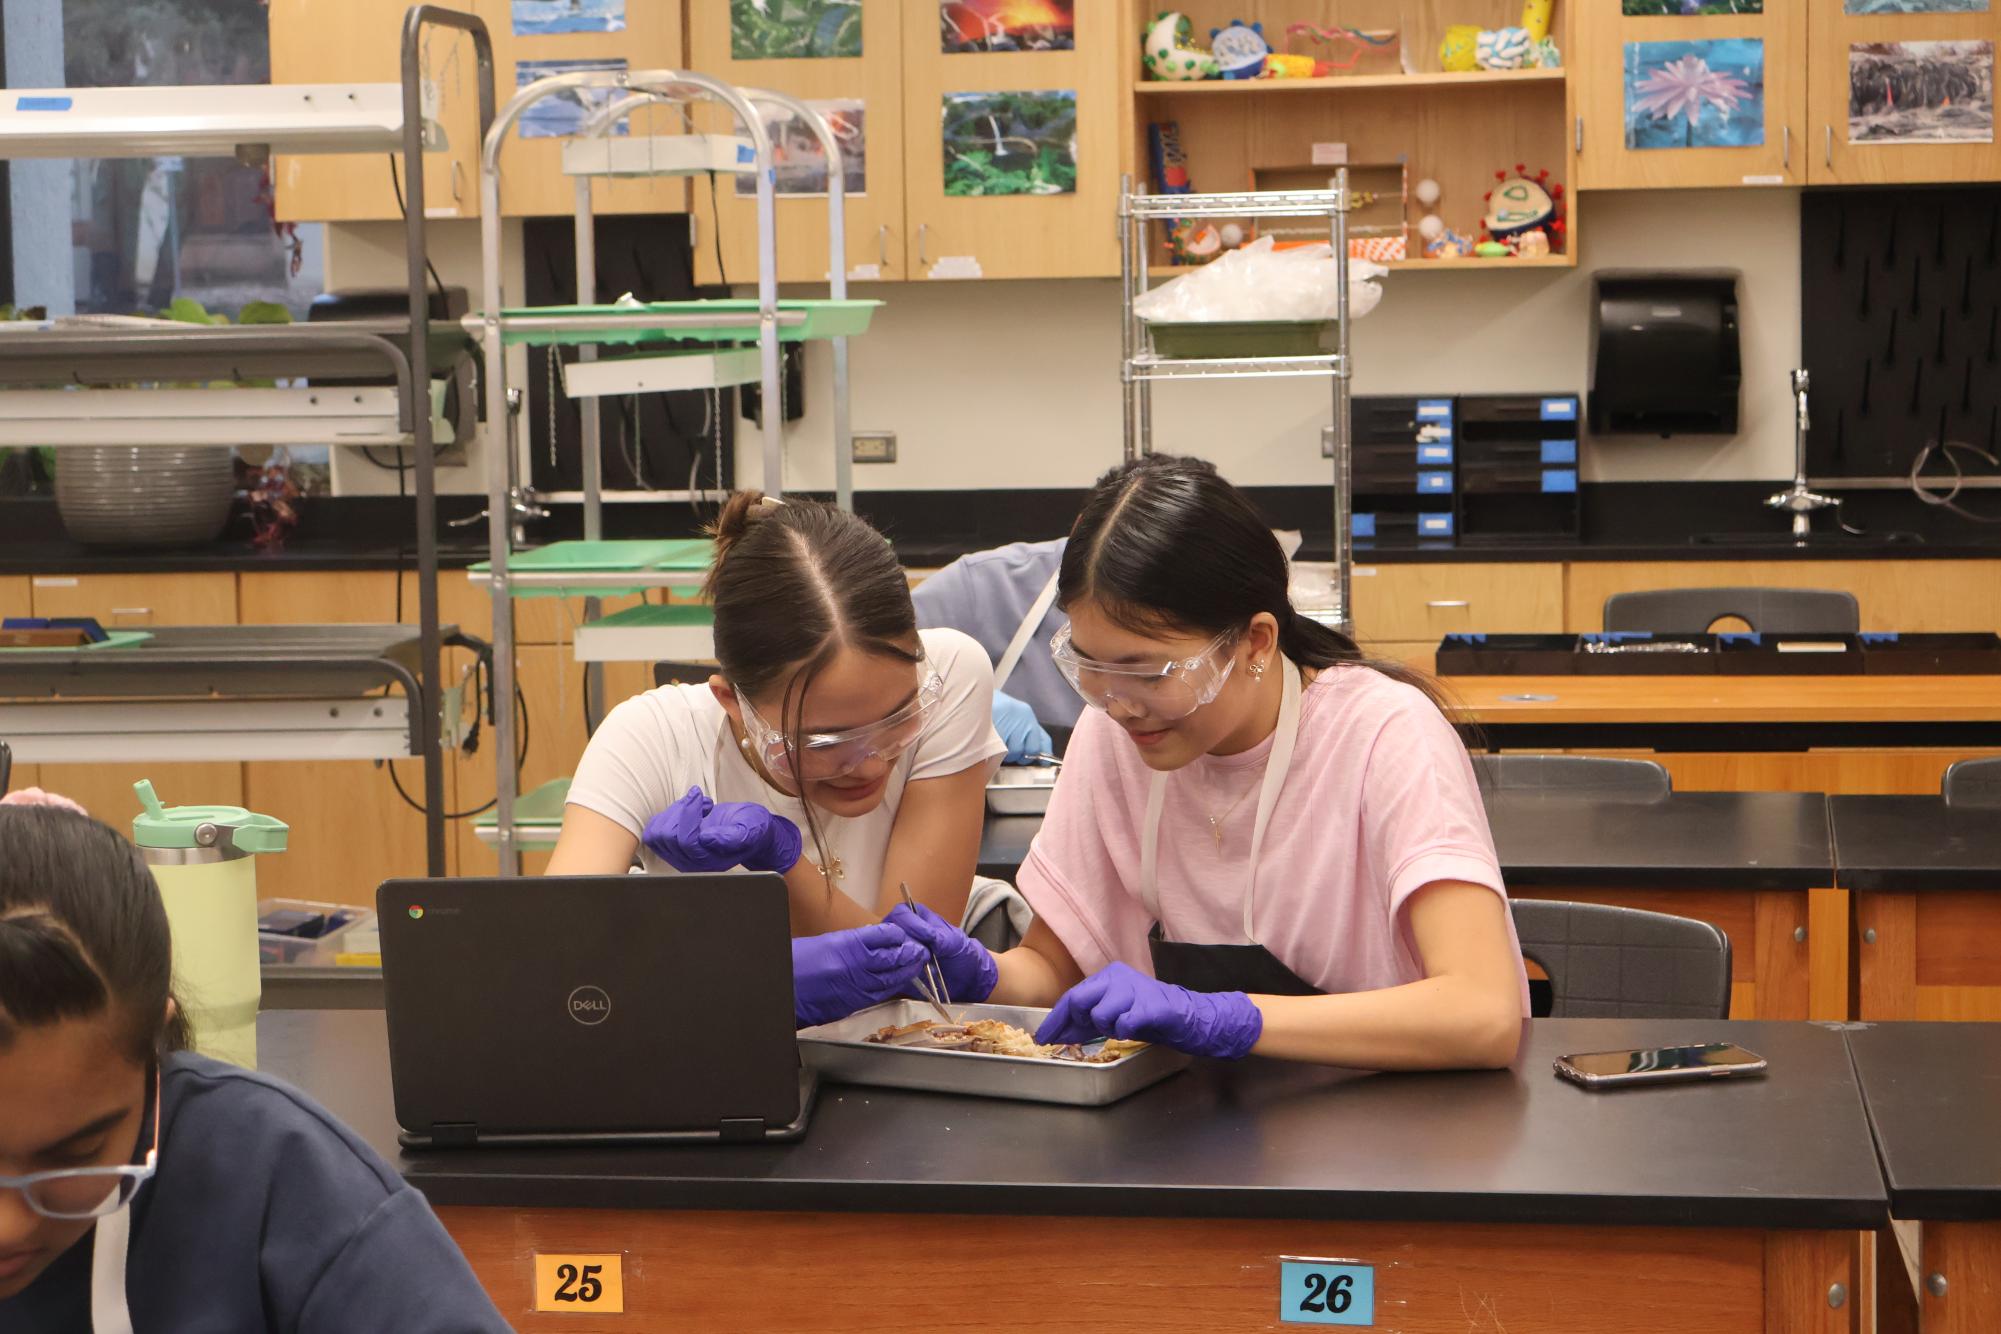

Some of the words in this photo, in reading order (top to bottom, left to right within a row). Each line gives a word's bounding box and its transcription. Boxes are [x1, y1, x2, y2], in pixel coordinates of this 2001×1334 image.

[573, 1000, 607, 1010] DELL
[554, 1263, 603, 1302] 25
[1299, 1273, 1354, 1314] 26
